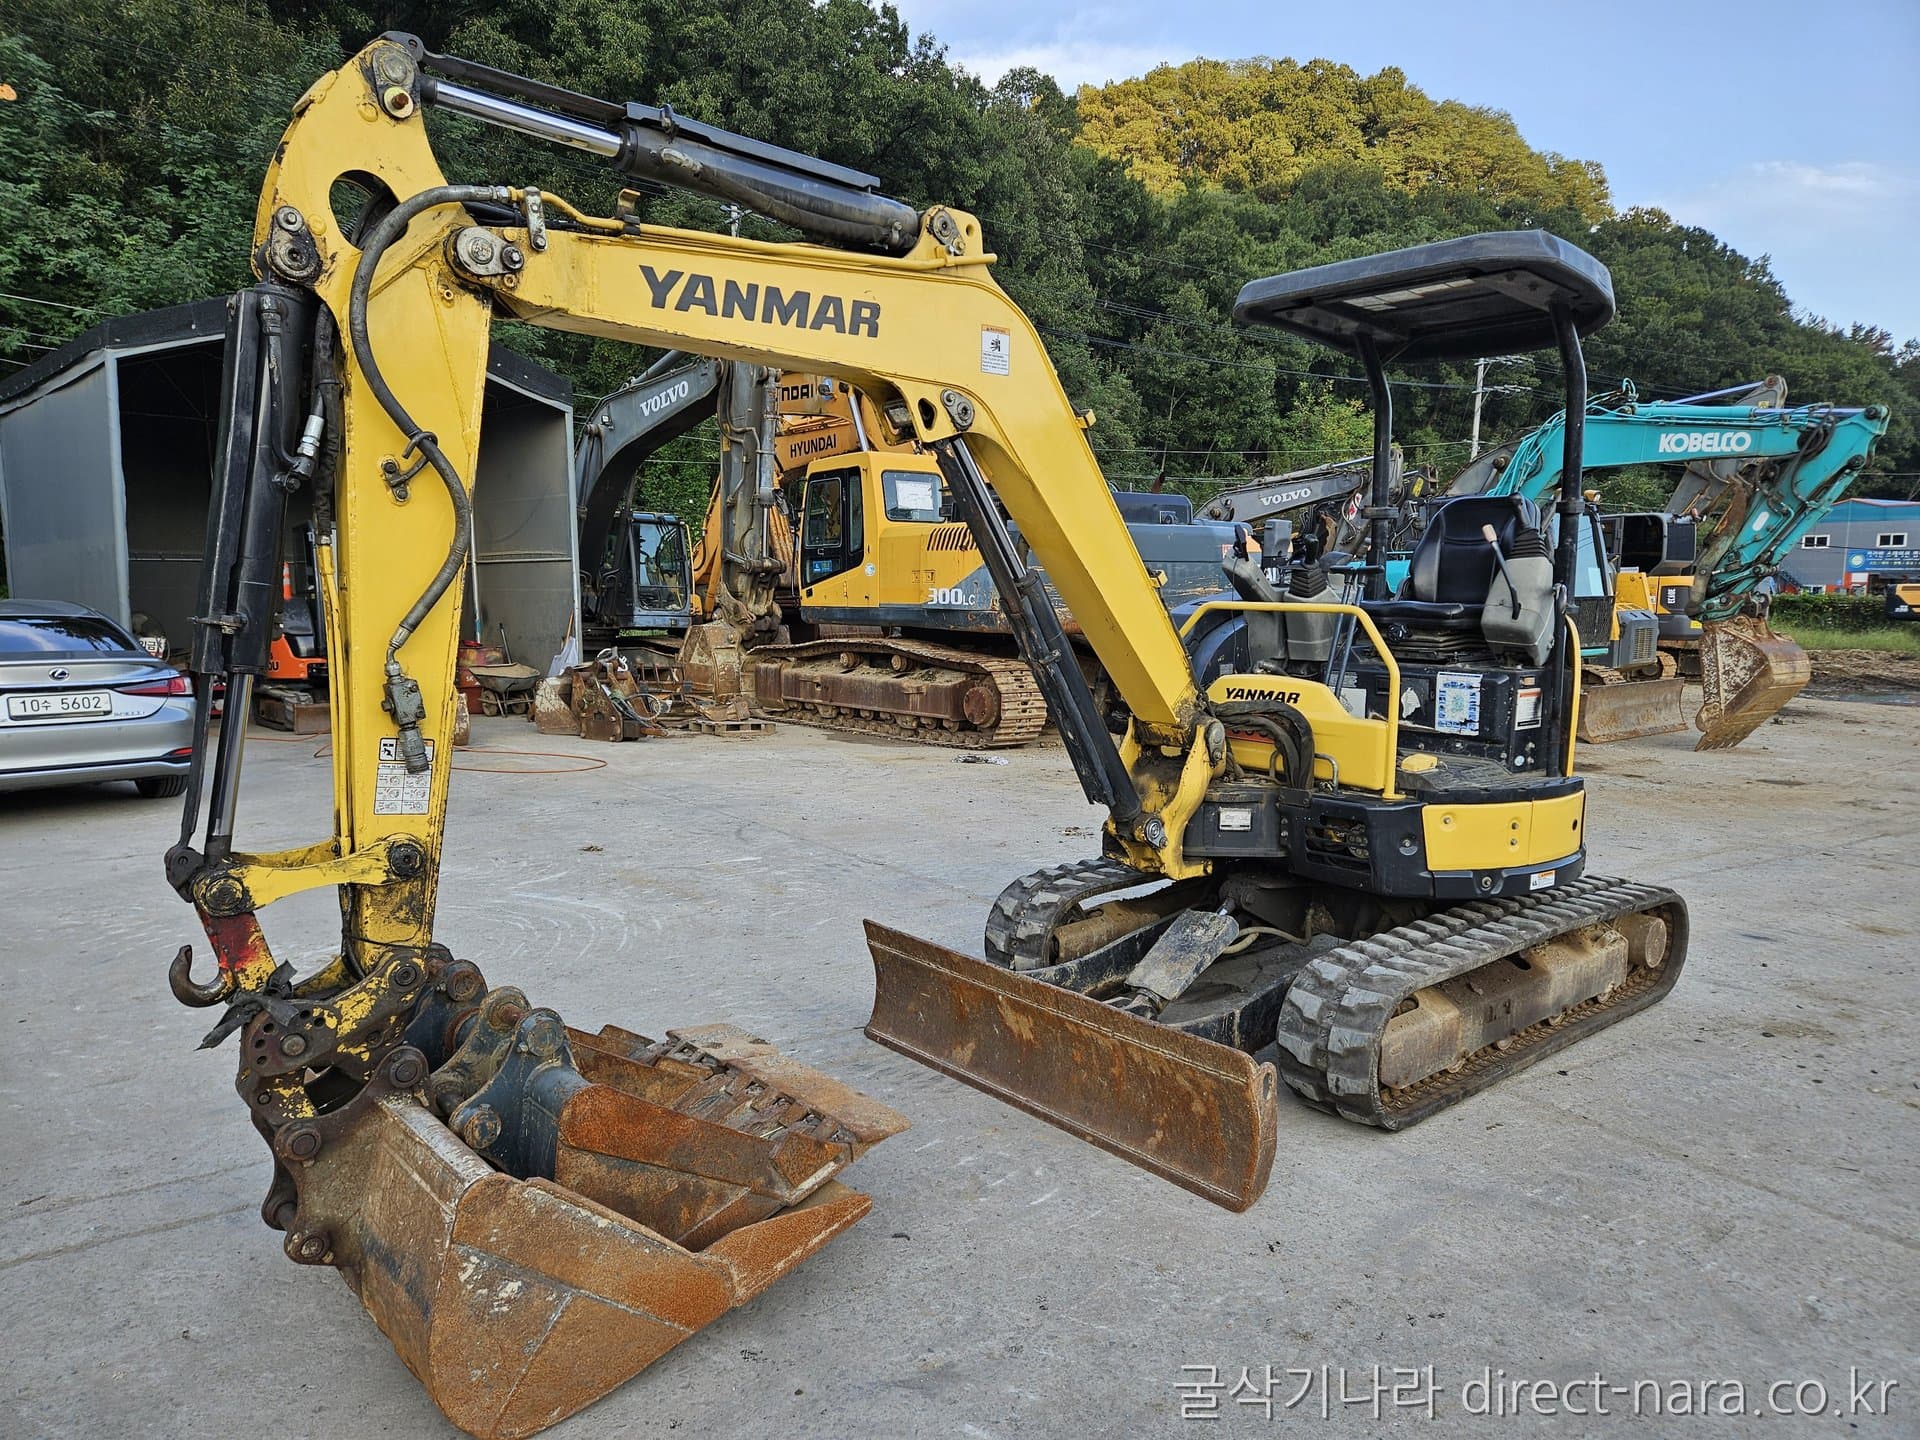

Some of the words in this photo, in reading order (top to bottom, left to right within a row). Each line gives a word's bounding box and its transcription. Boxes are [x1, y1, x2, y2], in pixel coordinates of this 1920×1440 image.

[640, 265, 881, 339] YANMAR
[639, 380, 689, 417] VOLVO
[790, 433, 837, 459] HYUNDAI
[1658, 431, 1752, 454] KOBELCO
[1260, 487, 1312, 506] VOLVO
[20, 698, 53, 713] 10수
[60, 696, 103, 711] 5602
[1225, 687, 1301, 705] YANMAR
